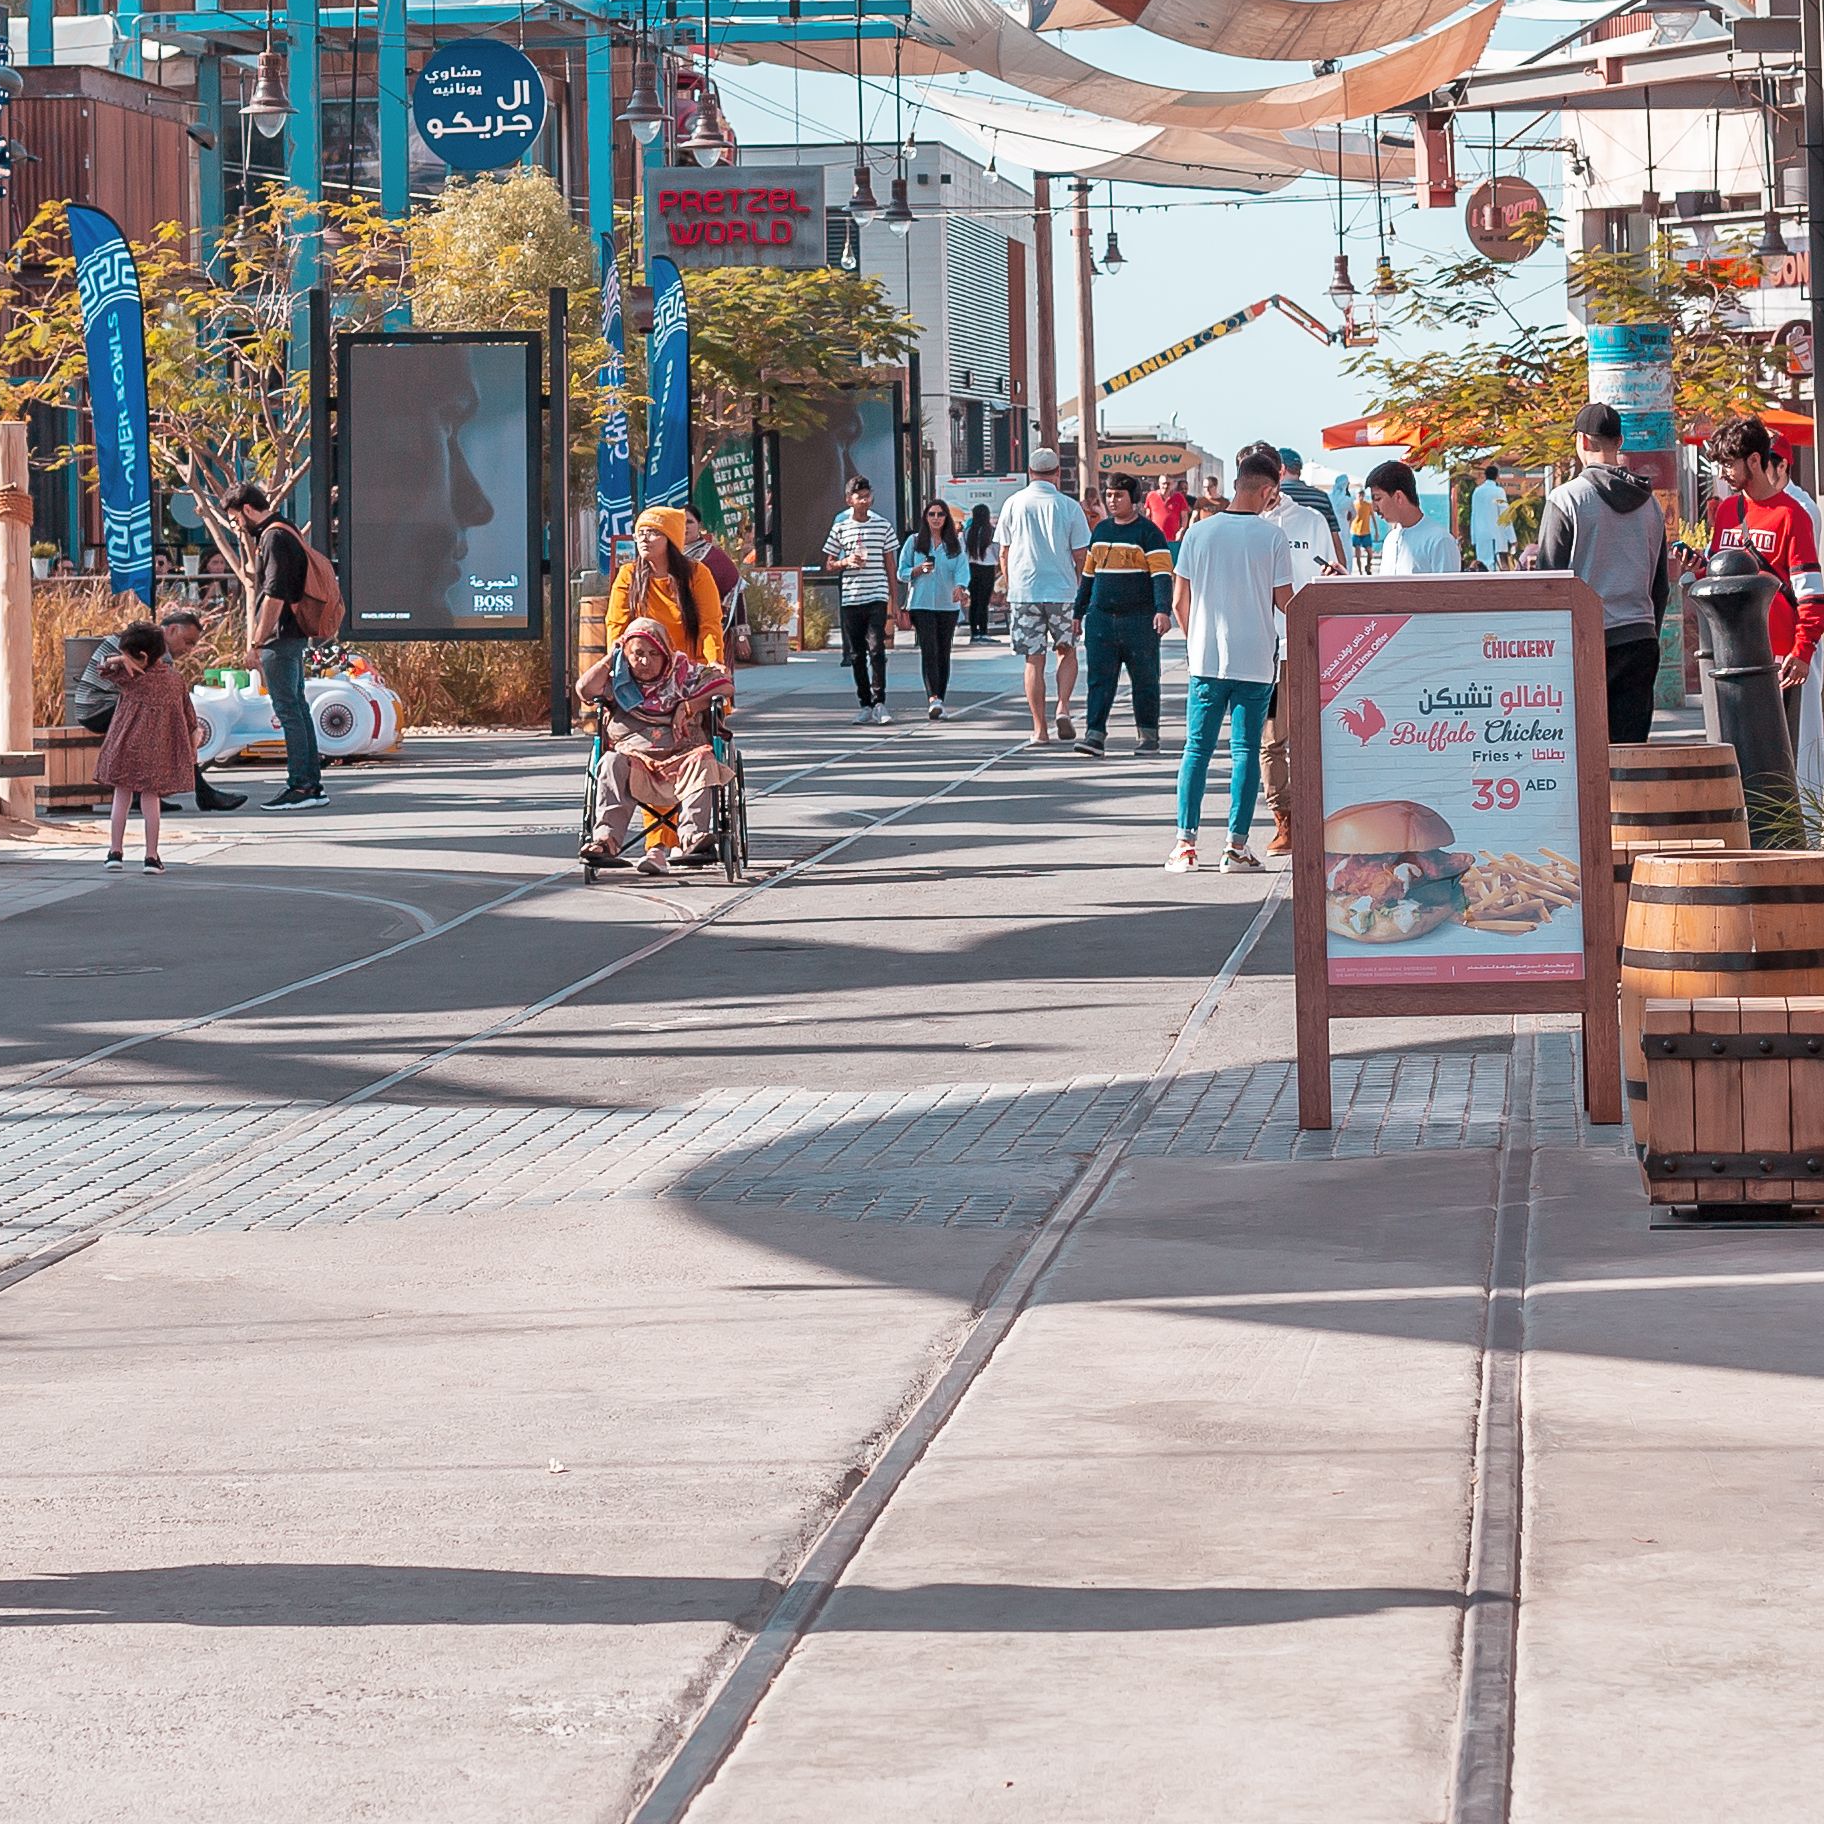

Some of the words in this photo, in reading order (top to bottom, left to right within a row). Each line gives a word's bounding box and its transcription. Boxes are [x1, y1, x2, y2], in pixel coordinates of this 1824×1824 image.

[425, 65, 482, 84] مشاوي
[433, 82, 482, 96] يونانيه
[496, 79, 531, 111] ال
[426, 112, 533, 139] جريكو
[668, 219, 793, 246] WORLD
[1108, 336, 1197, 392] MANLIFT
[1099, 451, 1183, 469] BUNGALOW
[474, 594, 514, 608] BOSS
[1332, 664, 1358, 692] Limited
[1356, 650, 1374, 667] Time
[1370, 632, 1390, 651] Offer
[1482, 639, 1556, 659] CHICKERY
[1418, 682, 1493, 715] تشيكن
[1499, 684, 1564, 716] بافالو
[1389, 720, 1477, 752] Buffalo
[1484, 719, 1564, 743] Chicken
[1472, 750, 1510, 763] Fries
[1532, 747, 1566, 763] بطاطا
[1471, 778, 1522, 811] 39
[1524, 778, 1557, 792] AED
